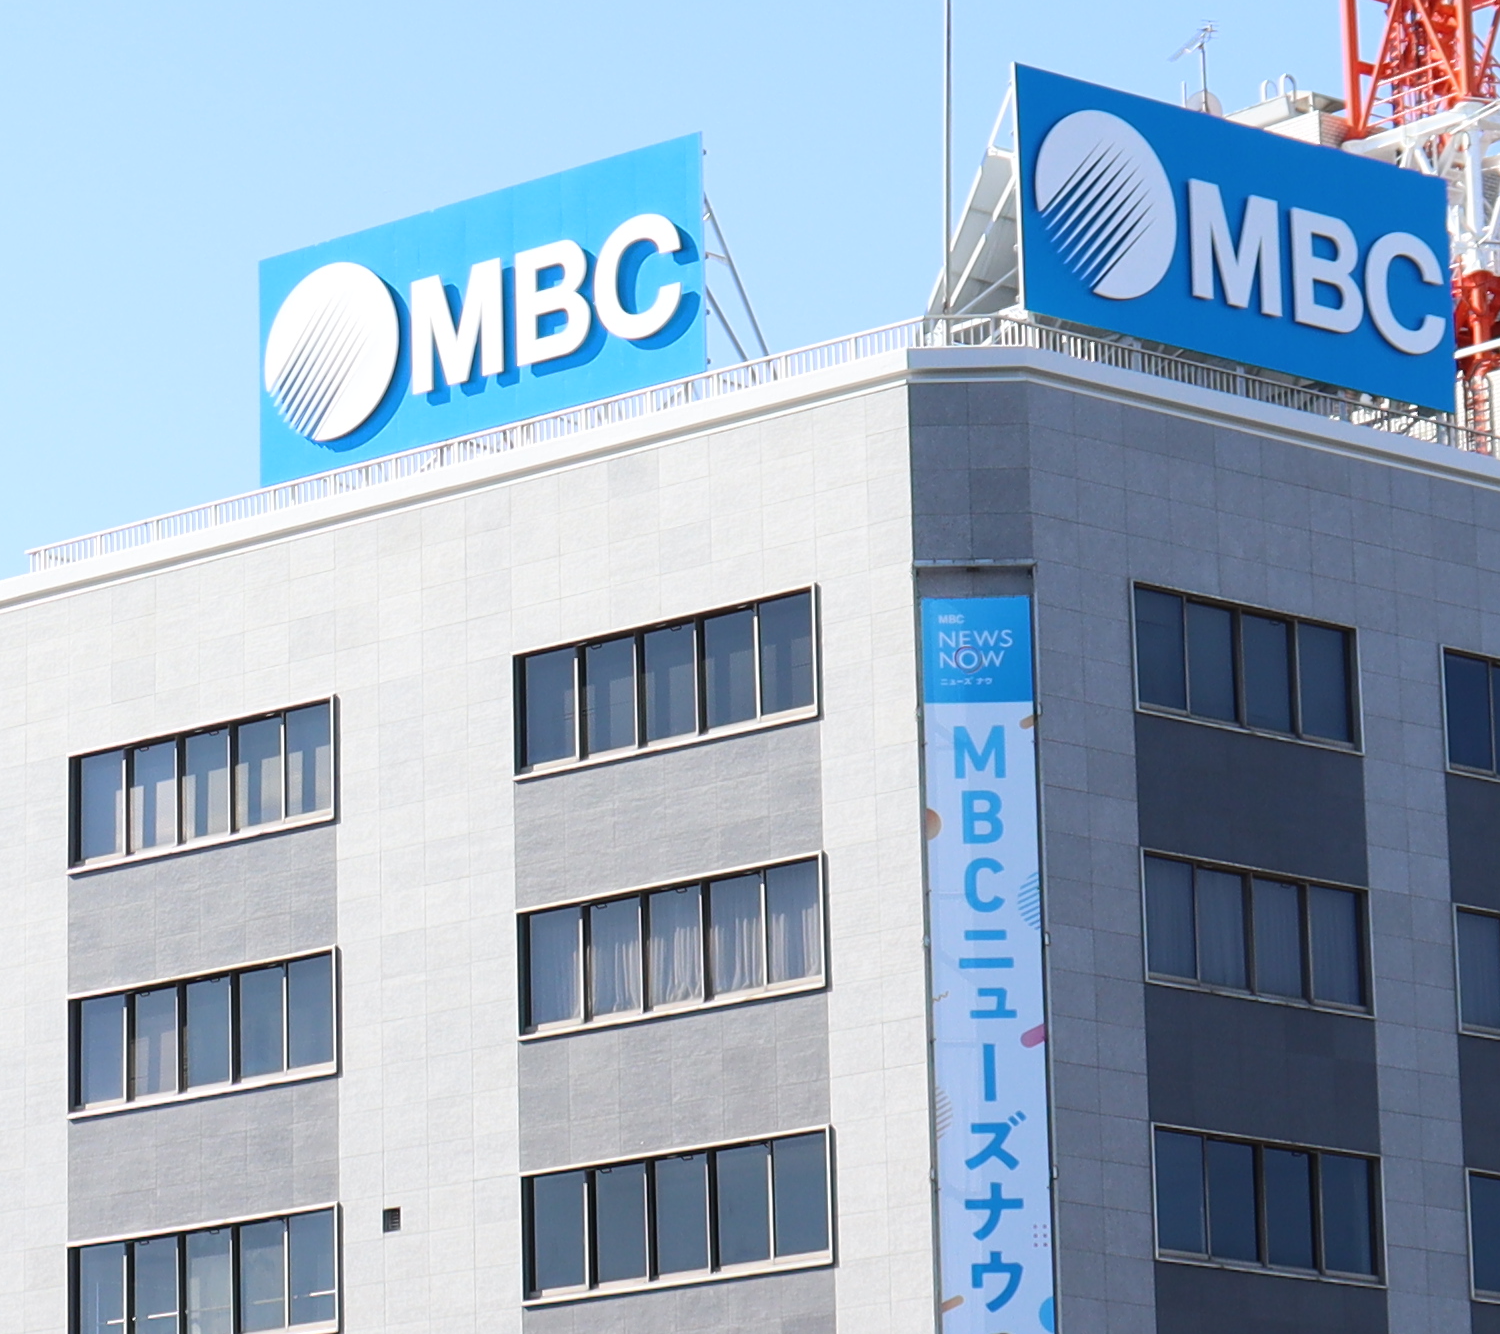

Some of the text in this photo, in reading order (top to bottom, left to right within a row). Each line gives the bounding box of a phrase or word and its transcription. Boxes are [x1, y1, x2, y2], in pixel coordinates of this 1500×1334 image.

[1187, 178, 1444, 357] MBC
[408, 212, 683, 397] MBC
[938, 614, 965, 624] MBC
[939, 629, 1013, 647] NEWS
[939, 650, 1005, 669] NOW
